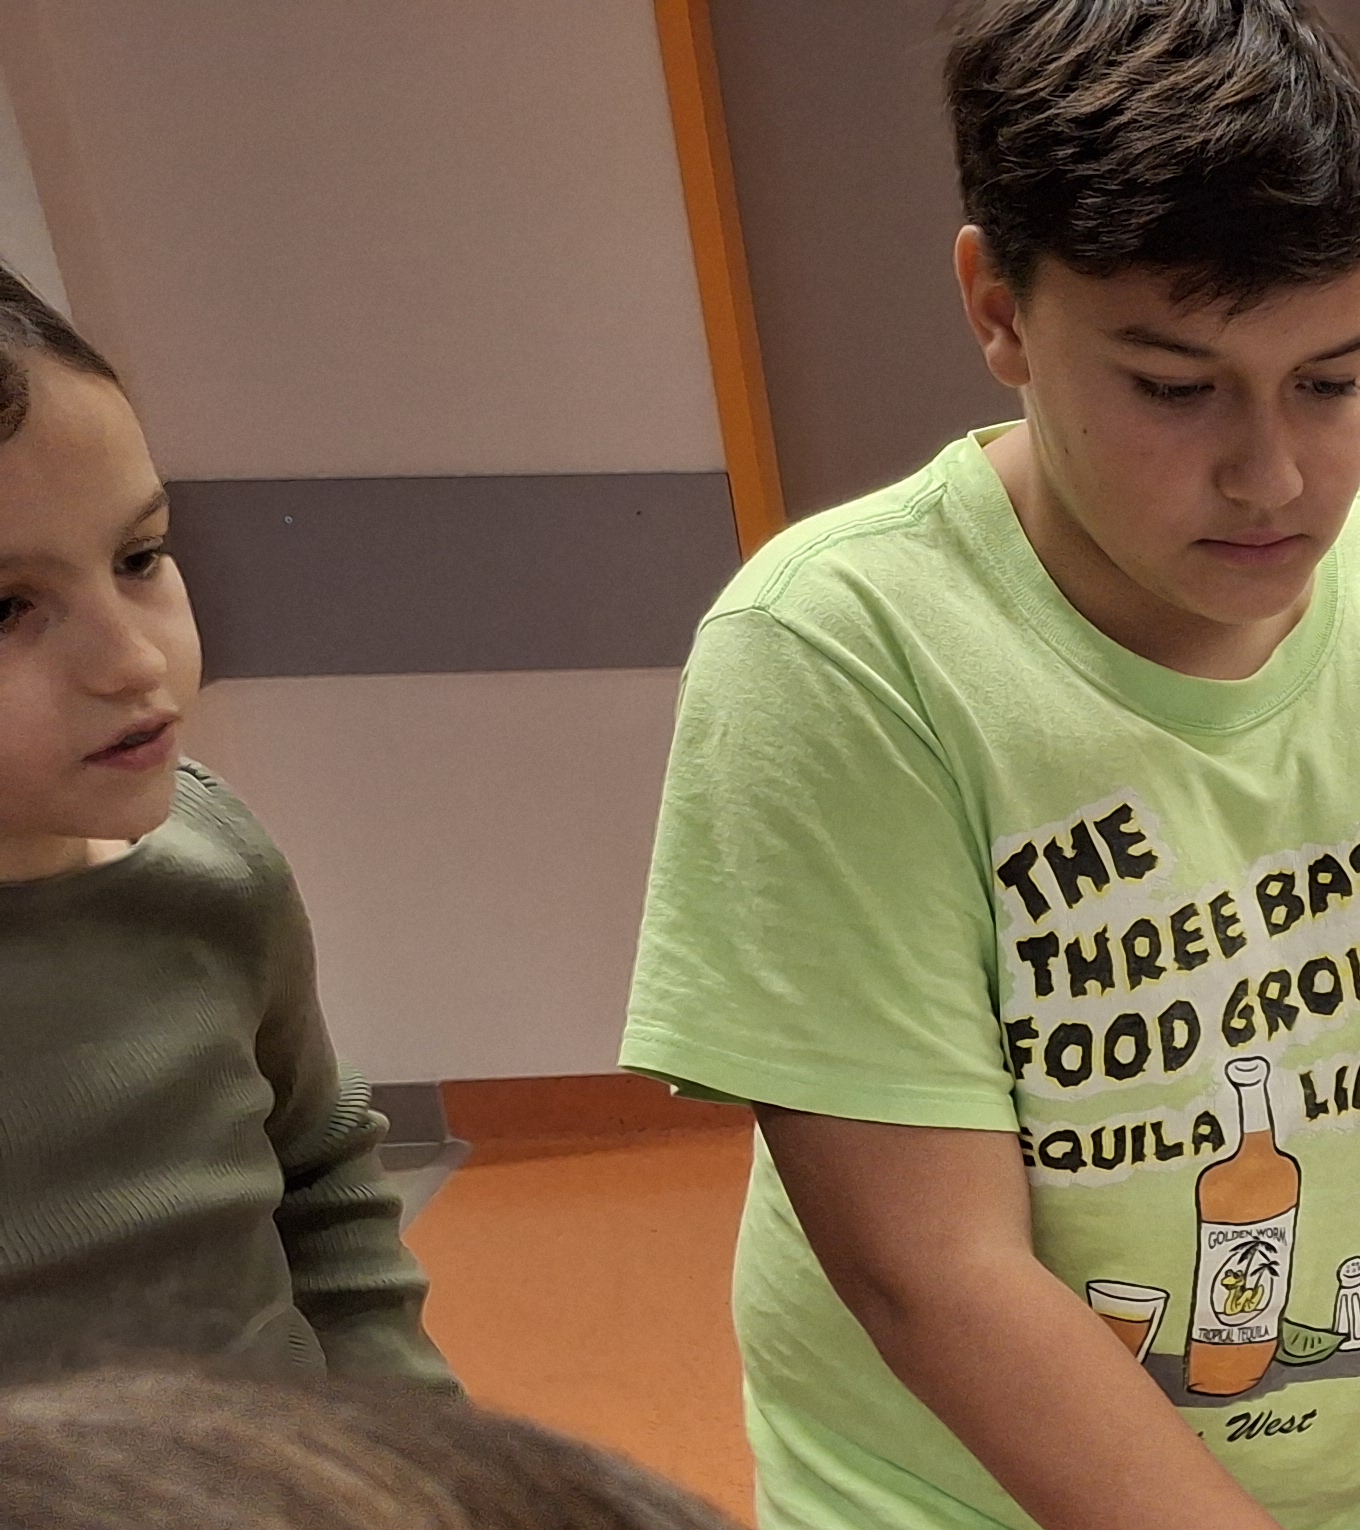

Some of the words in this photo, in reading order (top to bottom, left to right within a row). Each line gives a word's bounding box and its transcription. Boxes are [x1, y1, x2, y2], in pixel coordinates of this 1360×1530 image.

[997, 803, 1159, 923] THE
[1016, 890, 1248, 999] THREE
[1005, 1000, 1200, 1087] FOOD
[1208, 1229, 1253, 1249] GOLDEN
[1256, 1226, 1287, 1246] WORM
[1198, 1327, 1234, 1342] TROPICAL
[1238, 1325, 1270, 1342] TEQUILA
[1225, 1409, 1318, 1442] West
